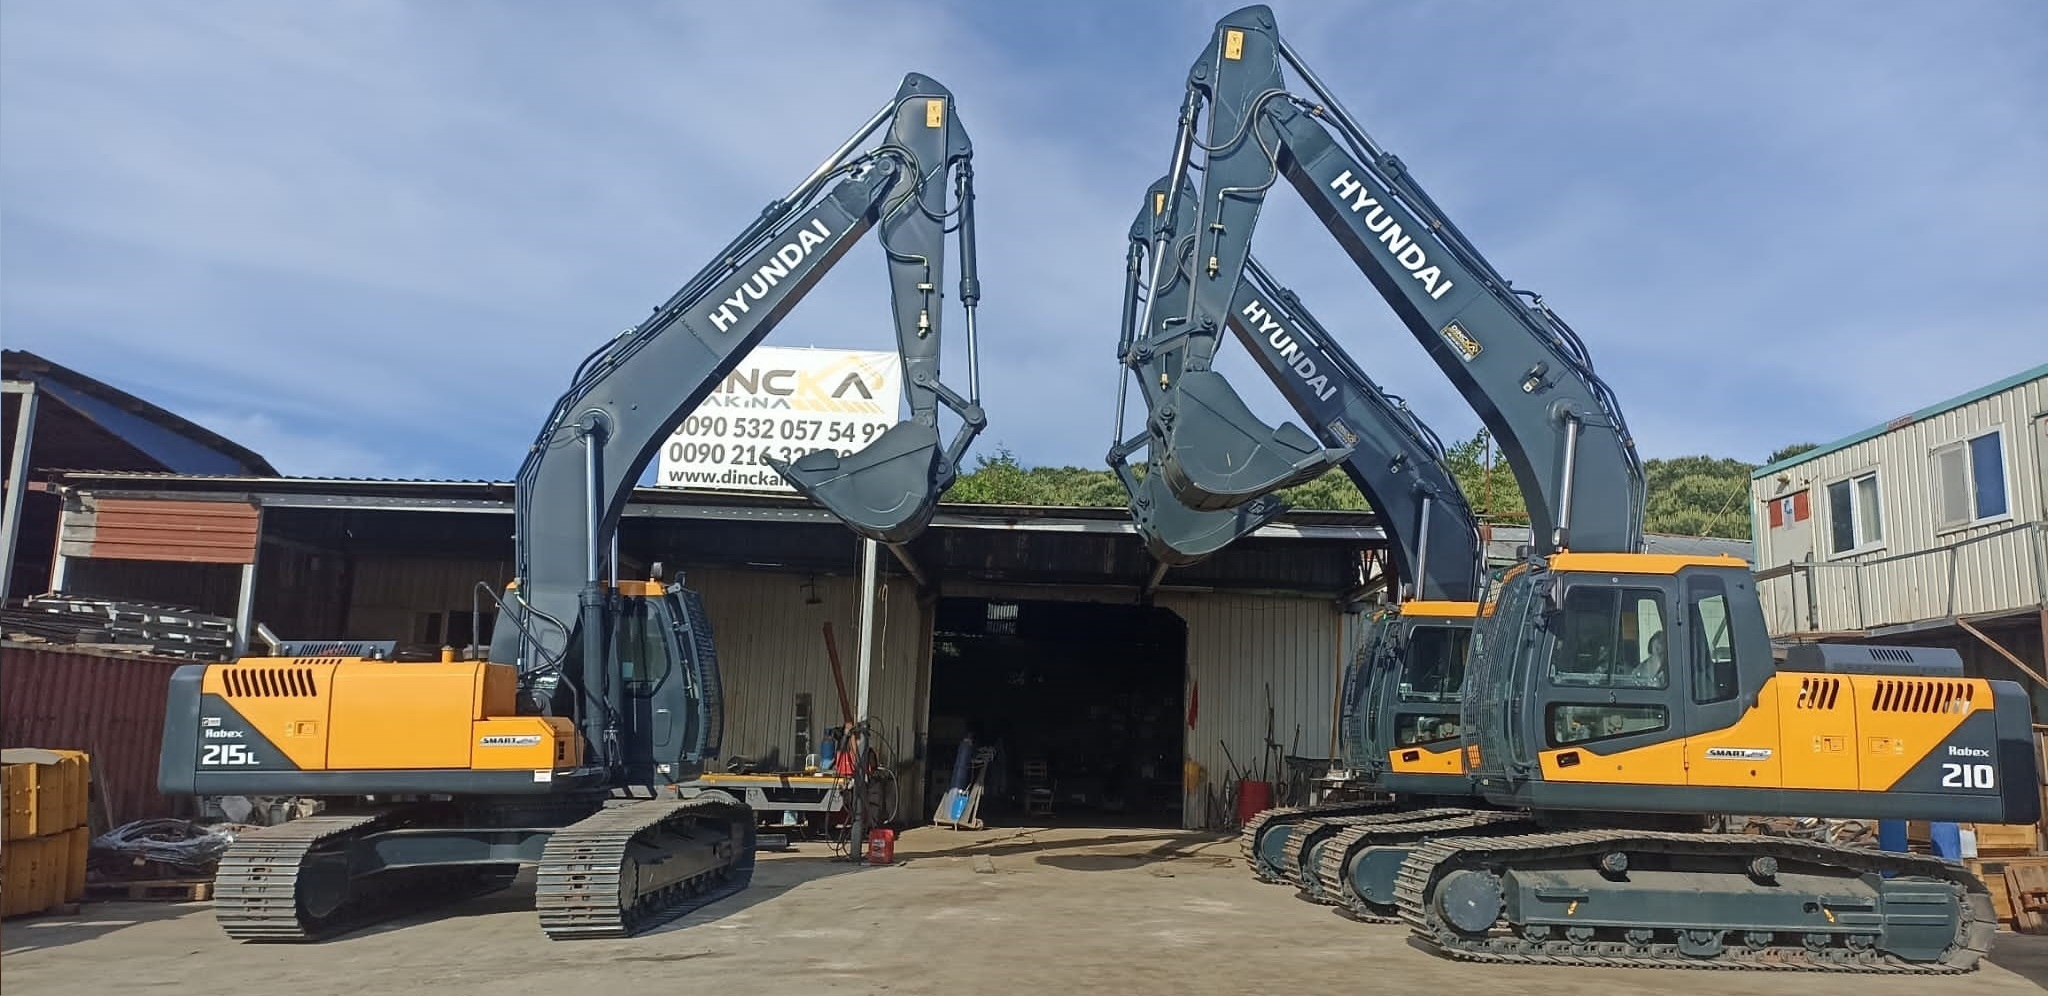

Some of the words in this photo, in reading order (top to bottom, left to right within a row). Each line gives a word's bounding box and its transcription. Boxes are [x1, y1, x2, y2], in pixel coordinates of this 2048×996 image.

[1330, 170, 1453, 300] HYUNDAI
[708, 218, 831, 333] HYUNDAI
[1242, 299, 1337, 402] HYUNDAI
[669, 442, 725, 464] 0090
[733, 418, 774, 439] 532
[780, 419, 822, 441] 057
[828, 421, 855, 443] 54
[1942, 763, 1994, 789] 210
